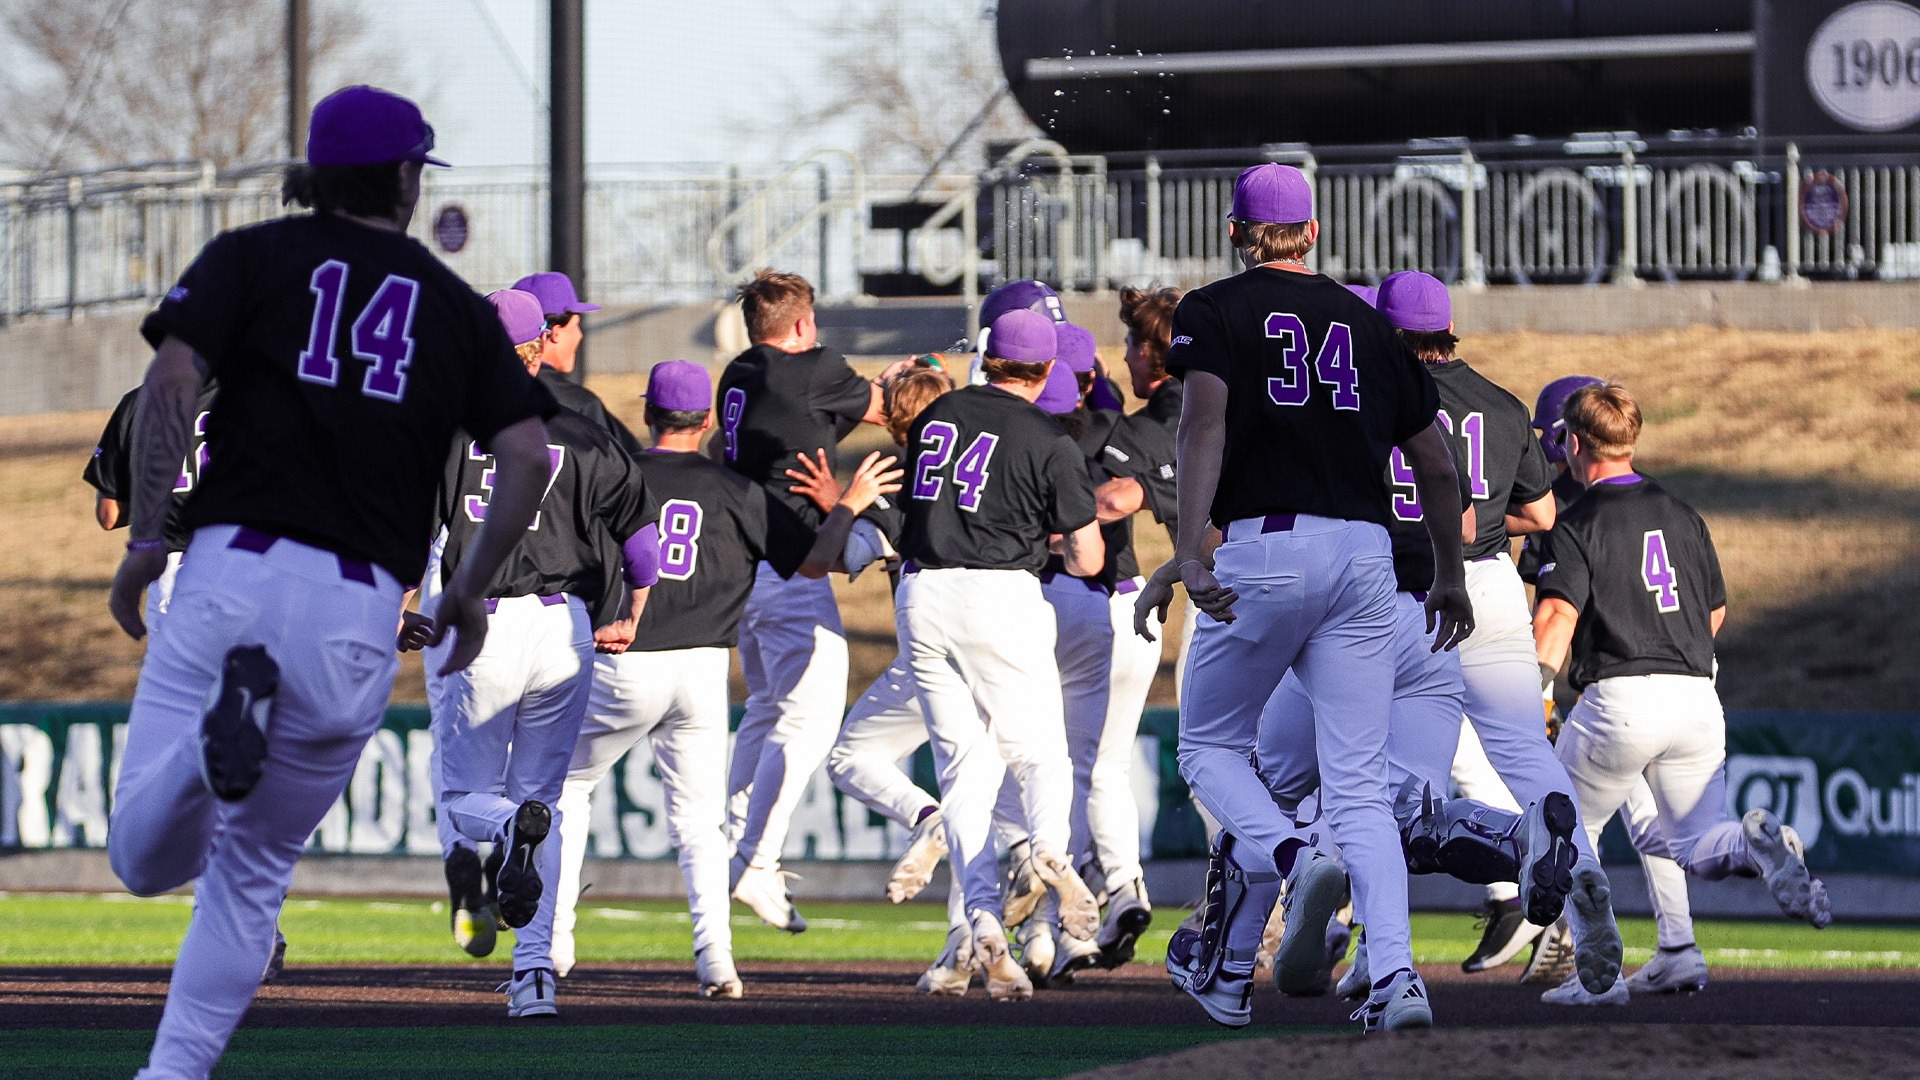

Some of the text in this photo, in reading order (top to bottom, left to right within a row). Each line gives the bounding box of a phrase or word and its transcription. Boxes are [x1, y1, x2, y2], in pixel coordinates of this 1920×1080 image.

[299, 259, 420, 402] 14
[1264, 312, 1360, 411] 34
[912, 420, 999, 513] 24
[1437, 409, 1489, 499] 1
[658, 499, 703, 581] 8
[1640, 529, 1680, 613] 4
